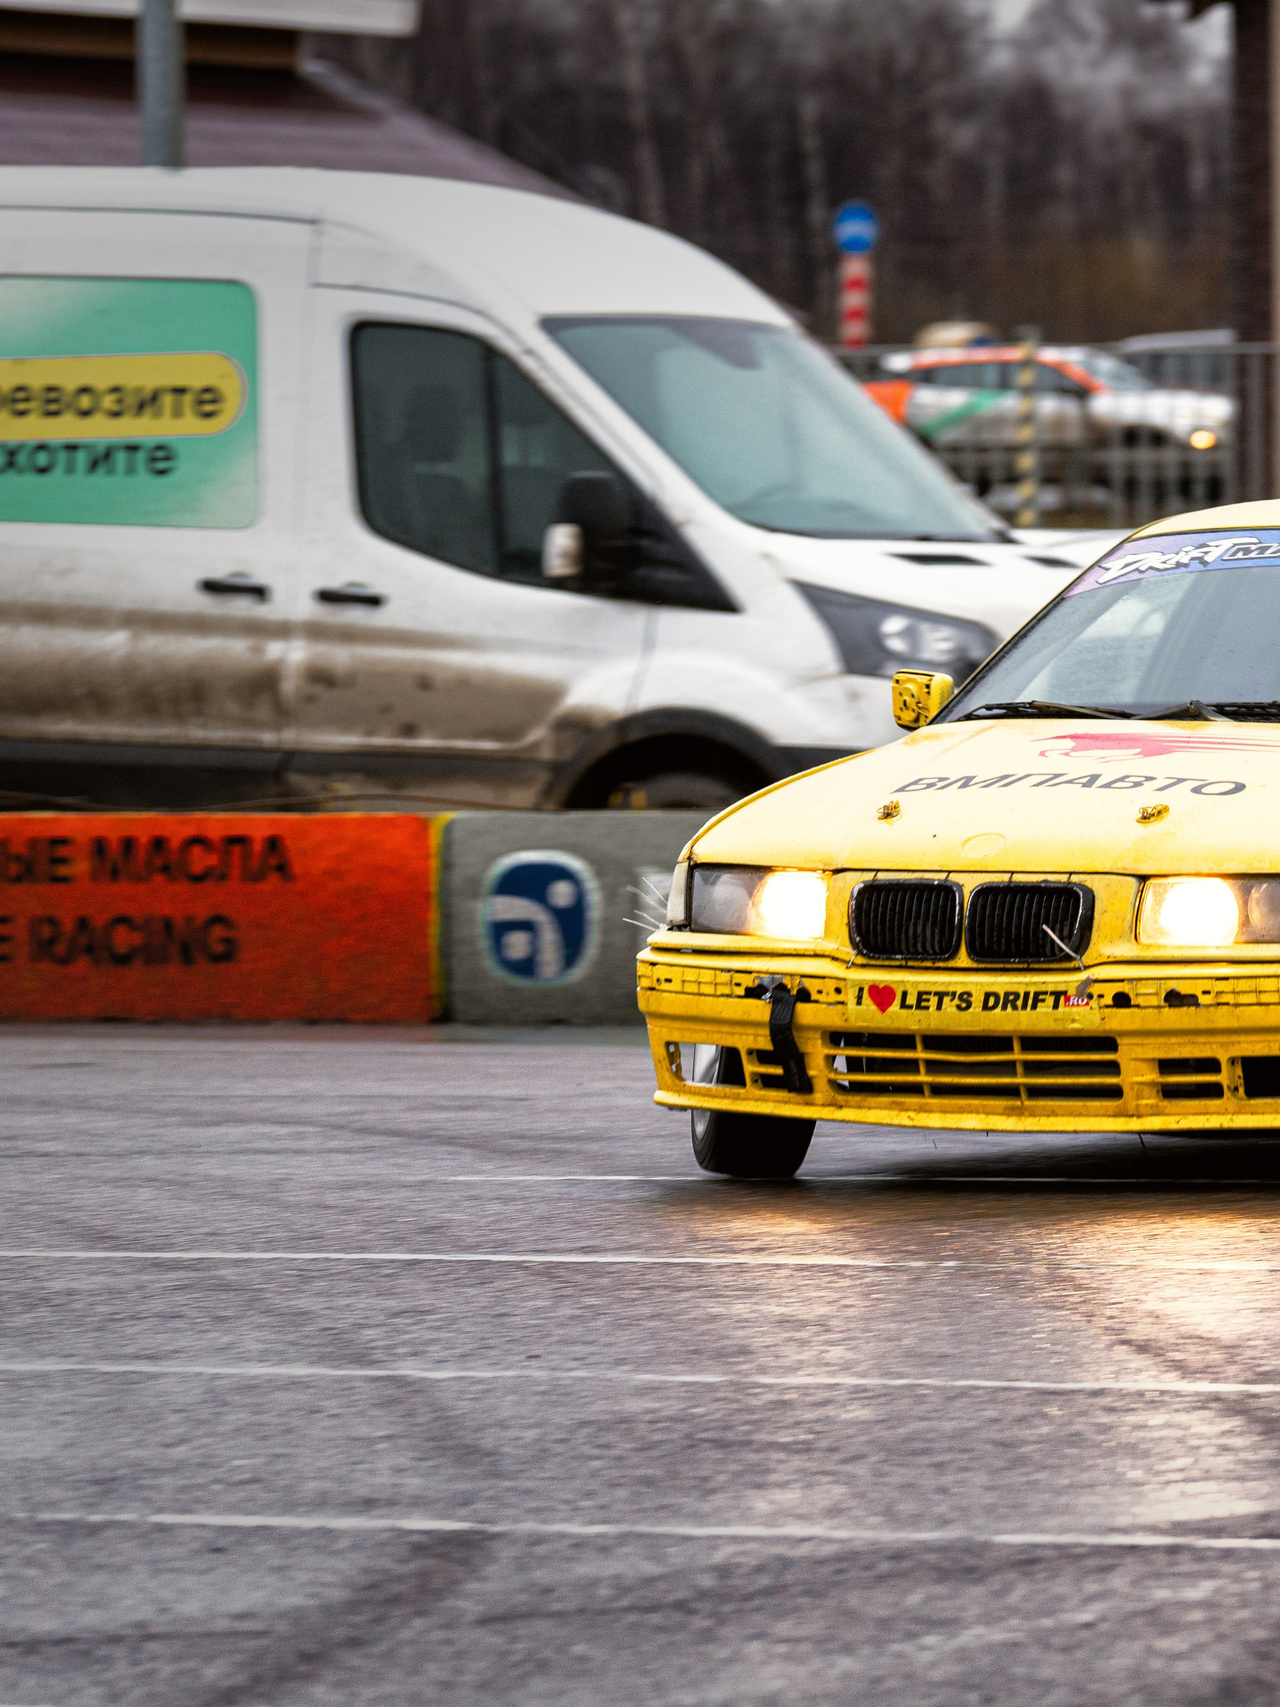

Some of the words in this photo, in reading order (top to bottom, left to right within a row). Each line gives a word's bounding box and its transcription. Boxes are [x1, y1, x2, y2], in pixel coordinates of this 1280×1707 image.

[890, 772, 1247, 797] ВМПАВТО
[88, 834, 297, 883] МАСЛА
[28, 914, 240, 967] RACING
[899, 990, 973, 1012] LET'S
